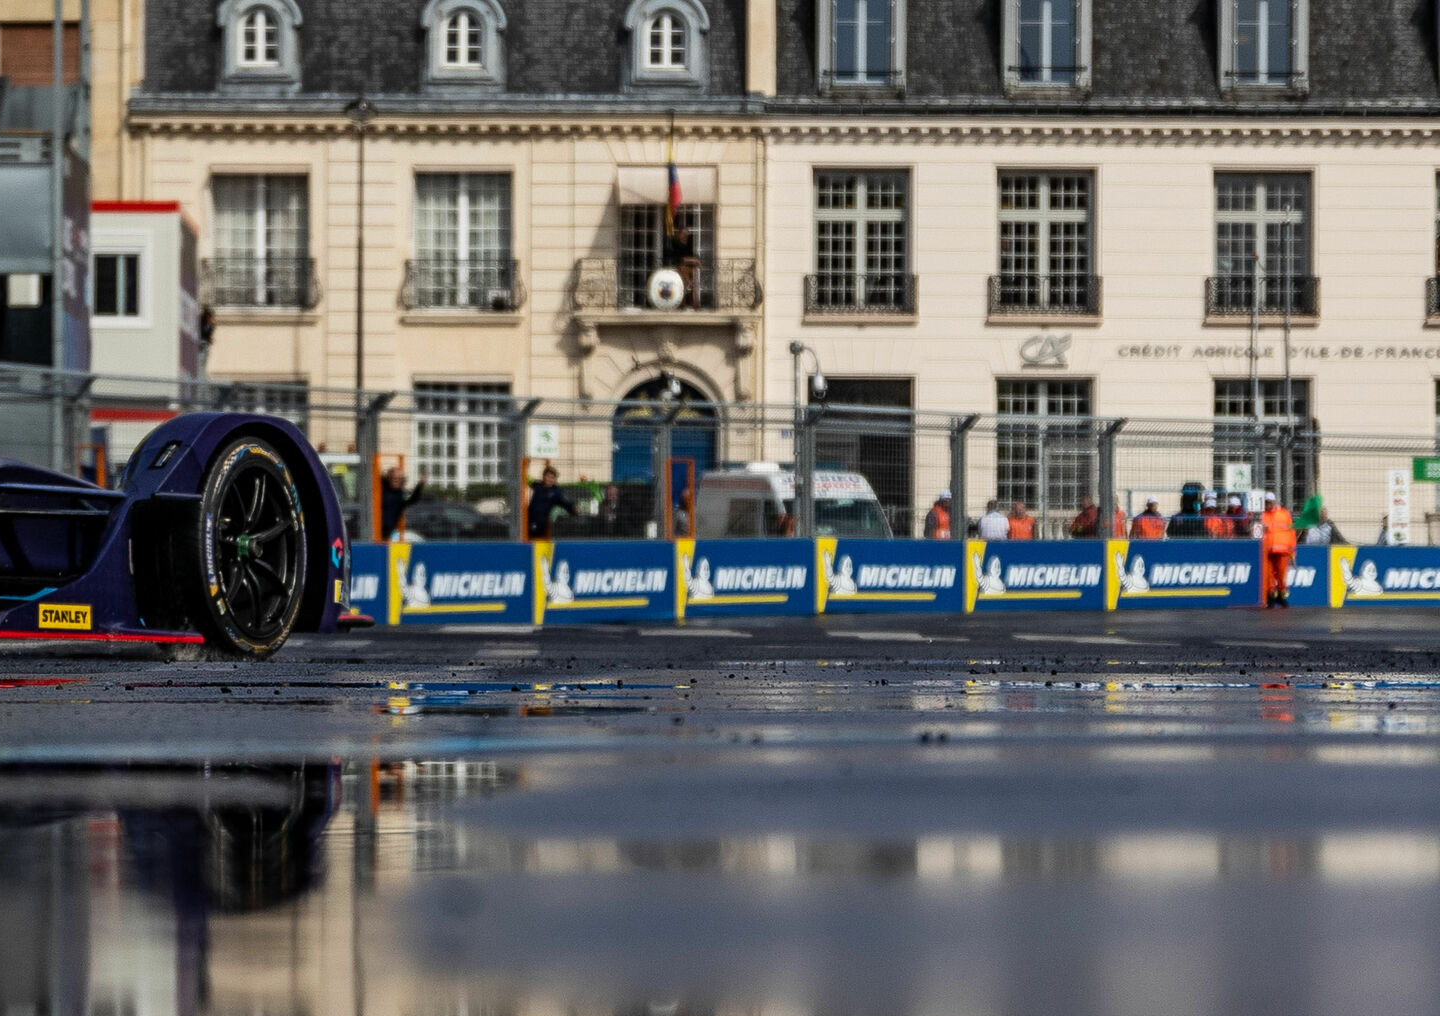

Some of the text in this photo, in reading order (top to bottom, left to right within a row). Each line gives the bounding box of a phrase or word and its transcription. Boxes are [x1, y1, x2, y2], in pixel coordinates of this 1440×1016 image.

[431, 572, 526, 598] MICHELIN
[574, 569, 668, 595] MICHELIN
[716, 566, 807, 591] MICHELIN
[859, 564, 956, 589] MICHELIN
[1007, 564, 1102, 587] MICHELIN
[1151, 562, 1251, 585] MICHELIN
[42, 609, 88, 624] STANLEY
